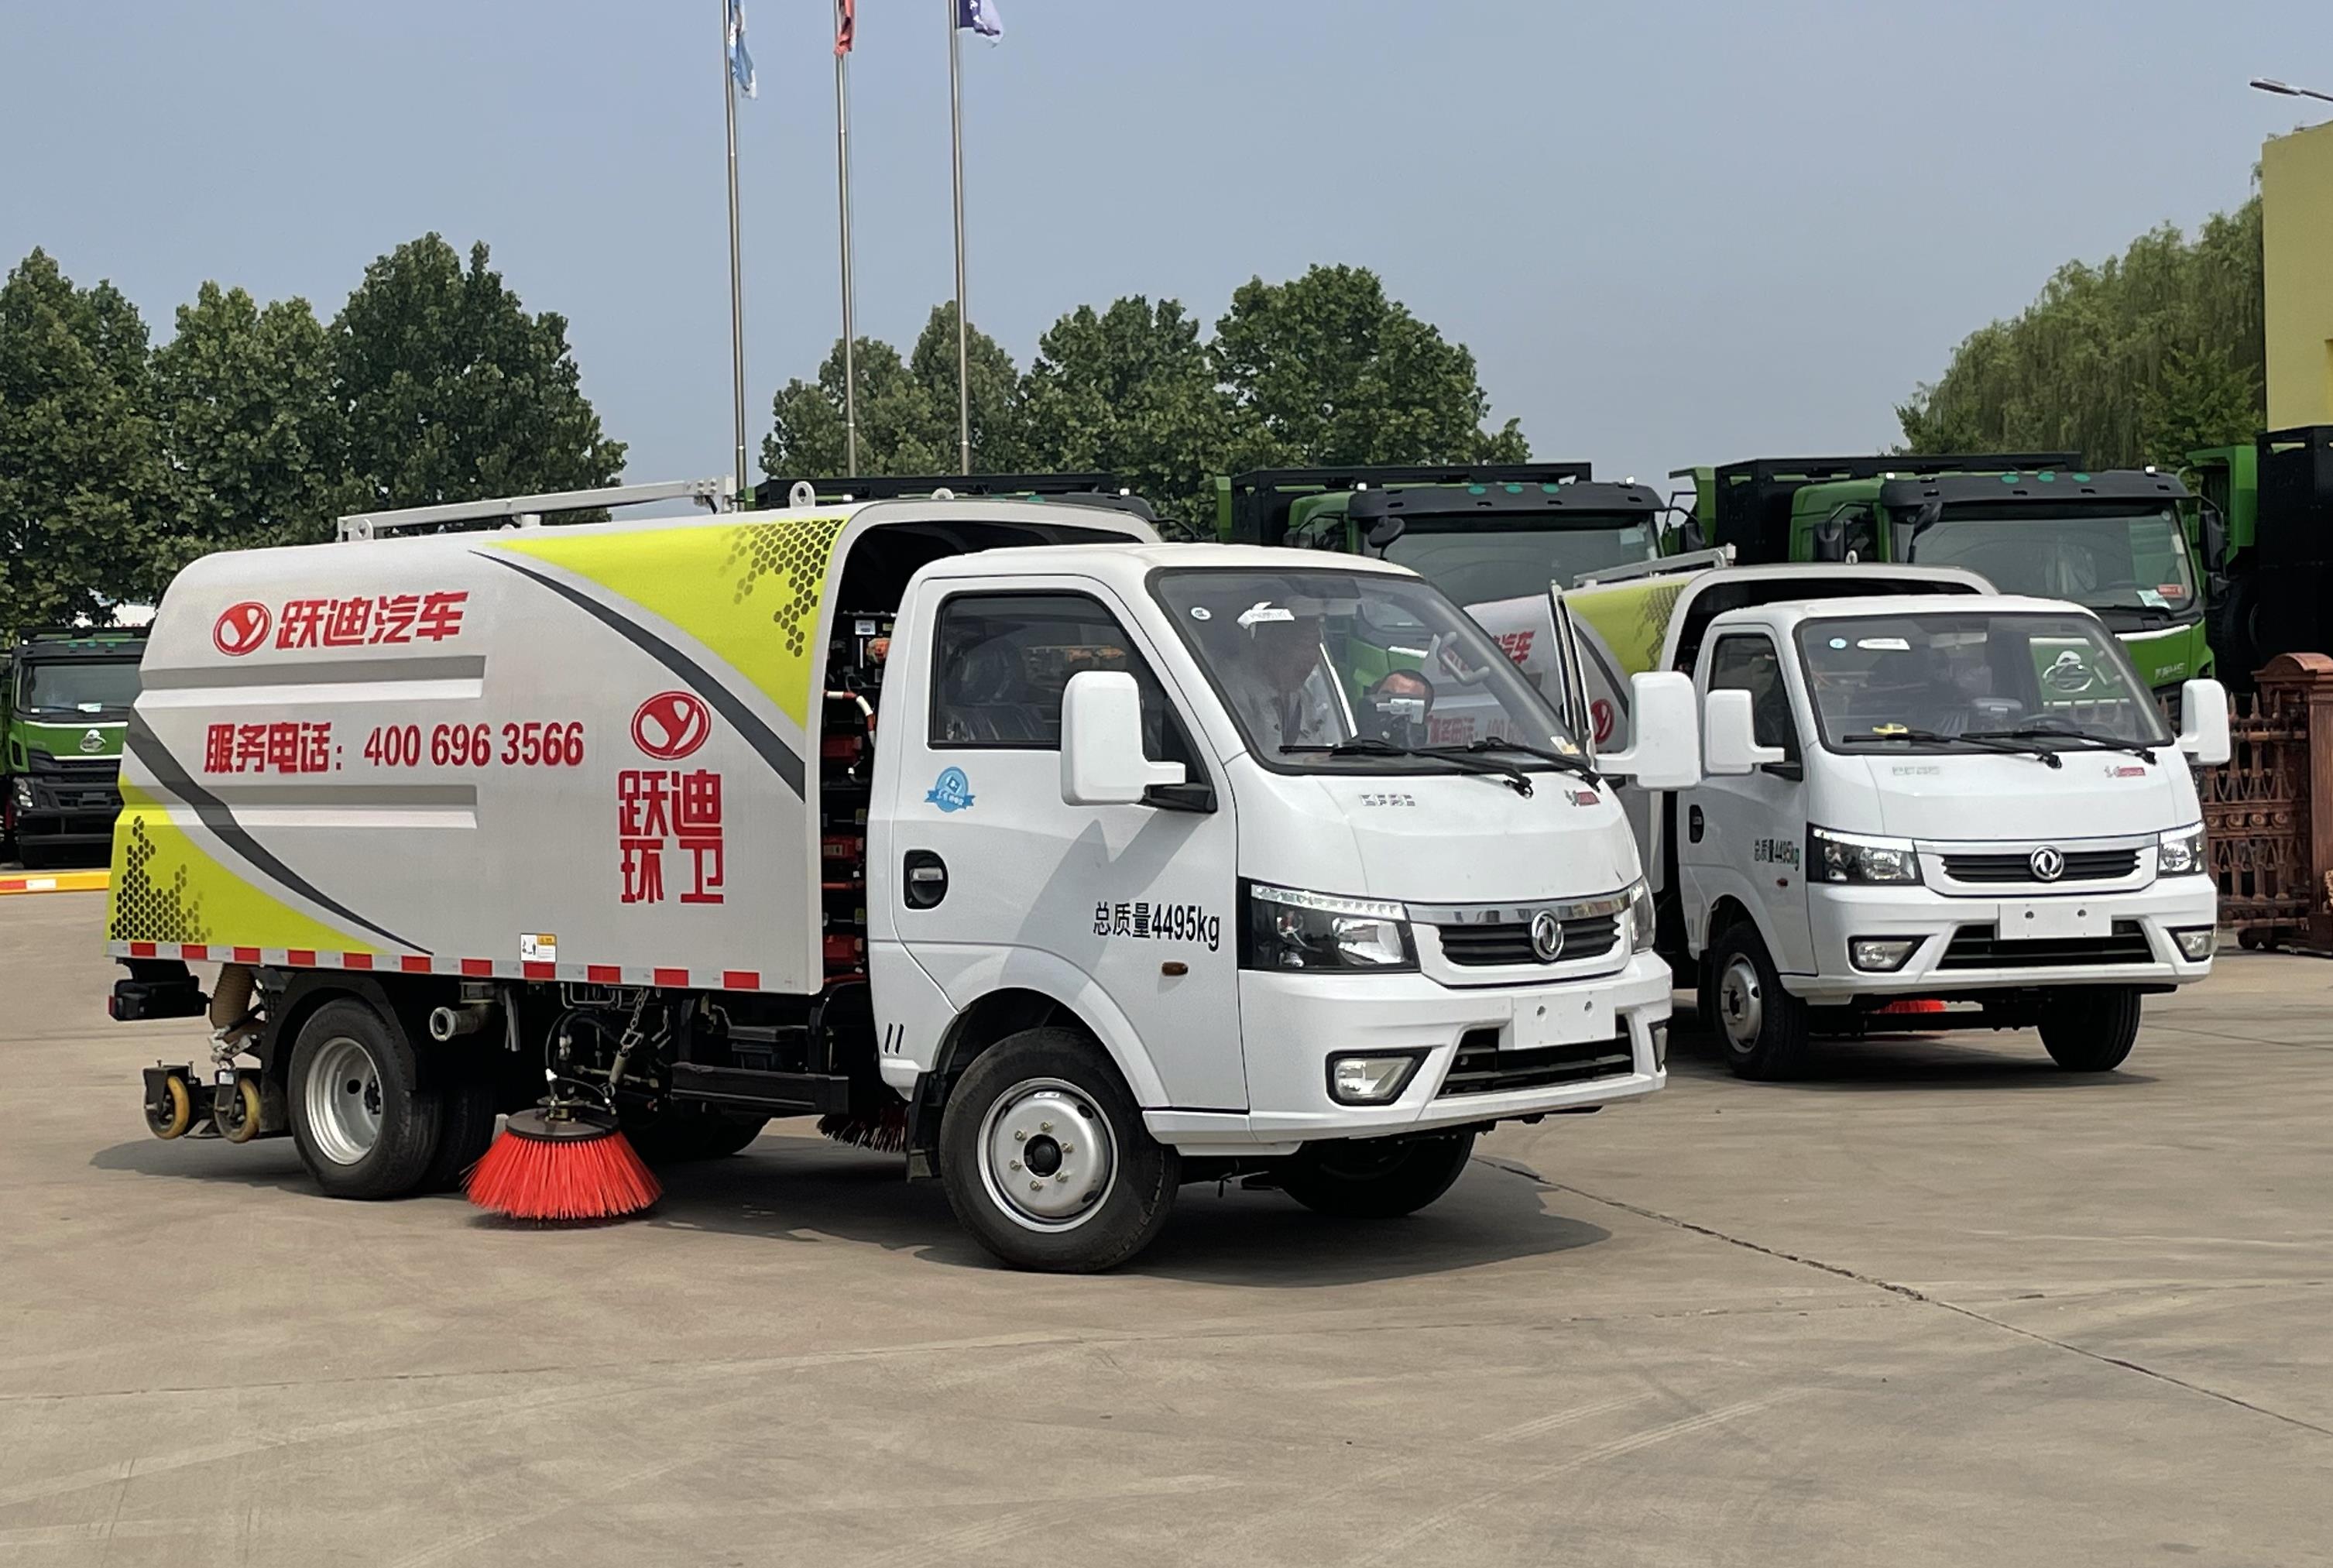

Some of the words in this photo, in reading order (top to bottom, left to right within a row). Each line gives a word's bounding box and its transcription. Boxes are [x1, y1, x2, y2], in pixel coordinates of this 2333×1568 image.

[275, 591, 468, 650] 跃迪汽车
[204, 721, 342, 774] 服务电话：
[363, 724, 421, 767] 400
[430, 722, 491, 767] 696
[500, 721, 584, 767] 3566
[618, 769, 722, 836] 跃迪
[619, 839, 724, 904] 环卫
[1093, 901, 1220, 952] 总质量4495kg
